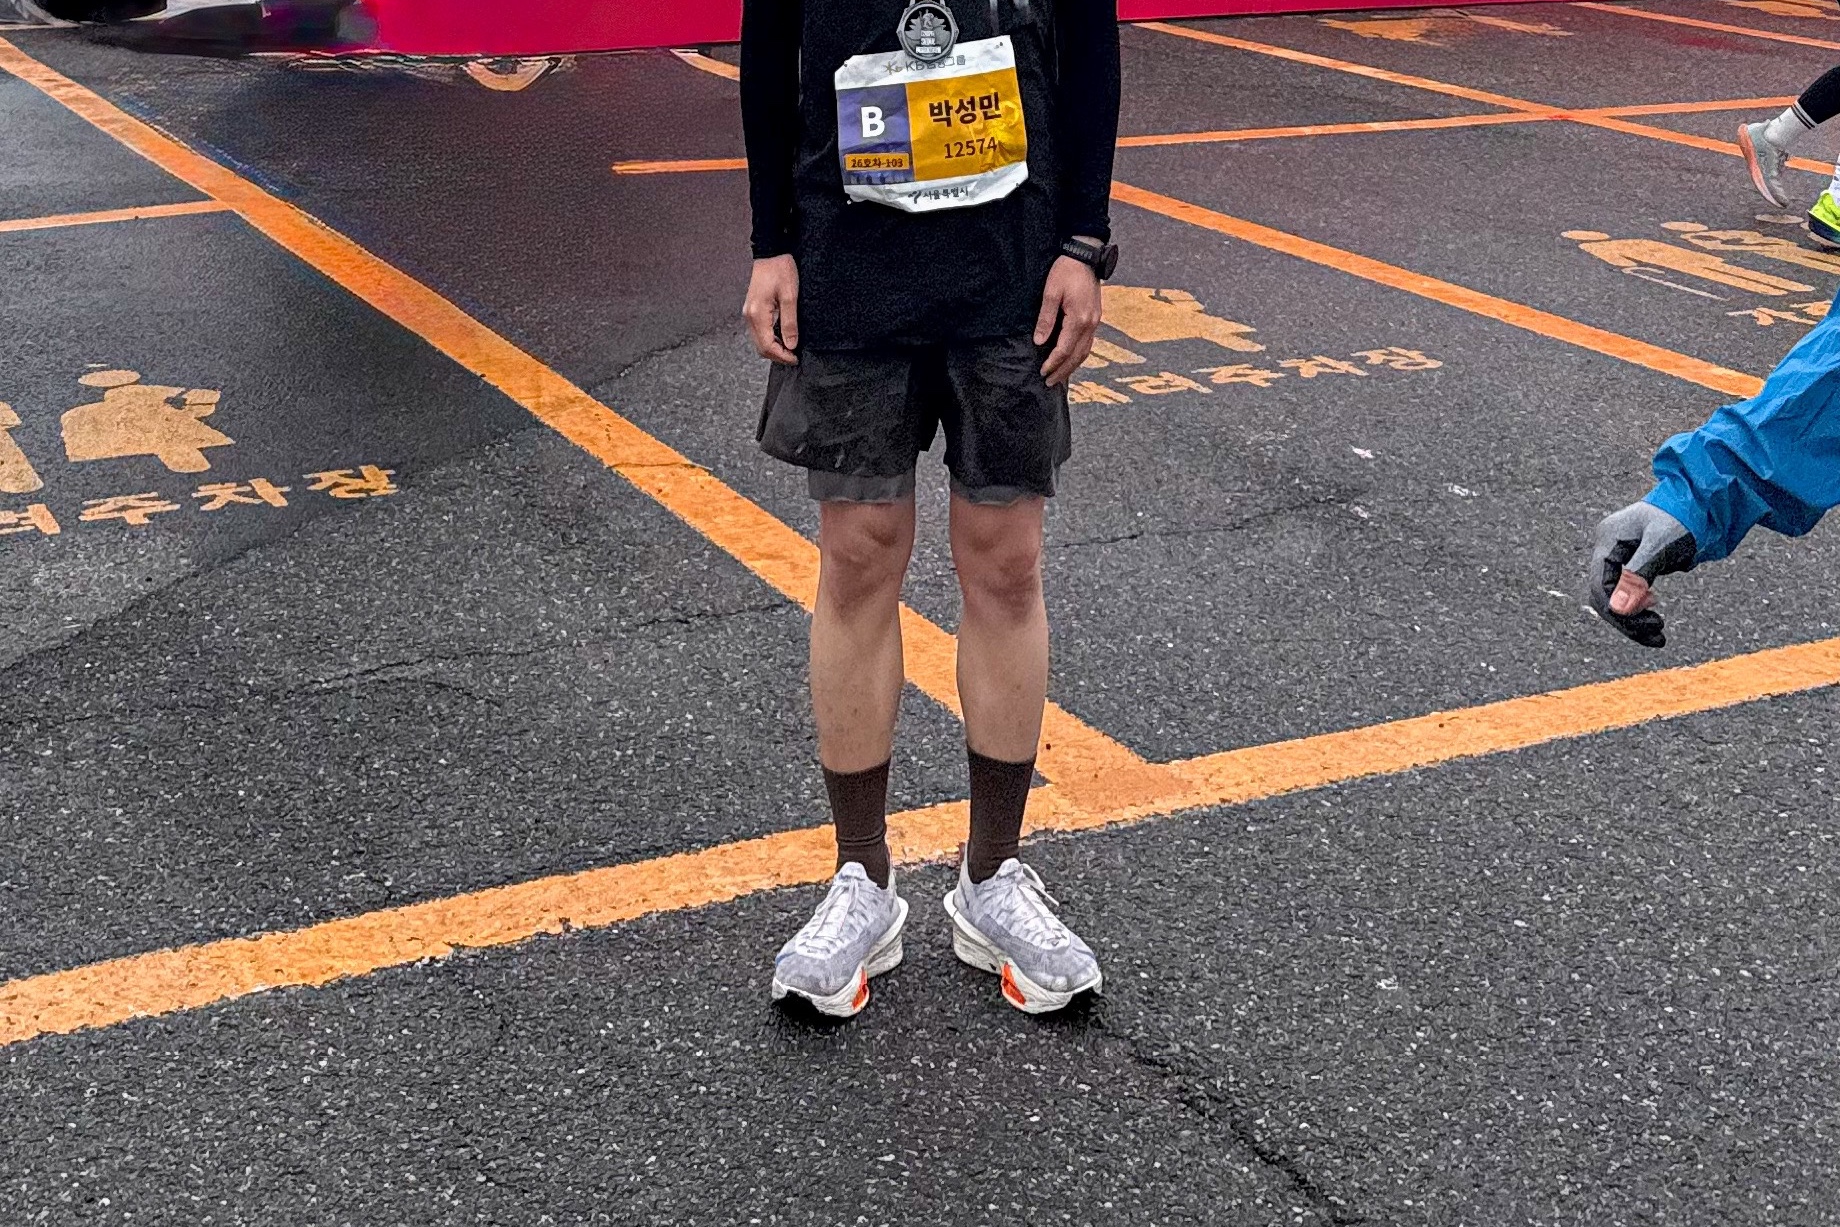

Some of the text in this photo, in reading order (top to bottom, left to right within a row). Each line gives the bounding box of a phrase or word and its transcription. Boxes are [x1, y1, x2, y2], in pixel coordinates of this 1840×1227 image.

[860, 106, 886, 139] B
[929, 92, 1002, 127] 박성민
[944, 137, 998, 159] 12574
[923, 186, 969, 200] 서울특별시
